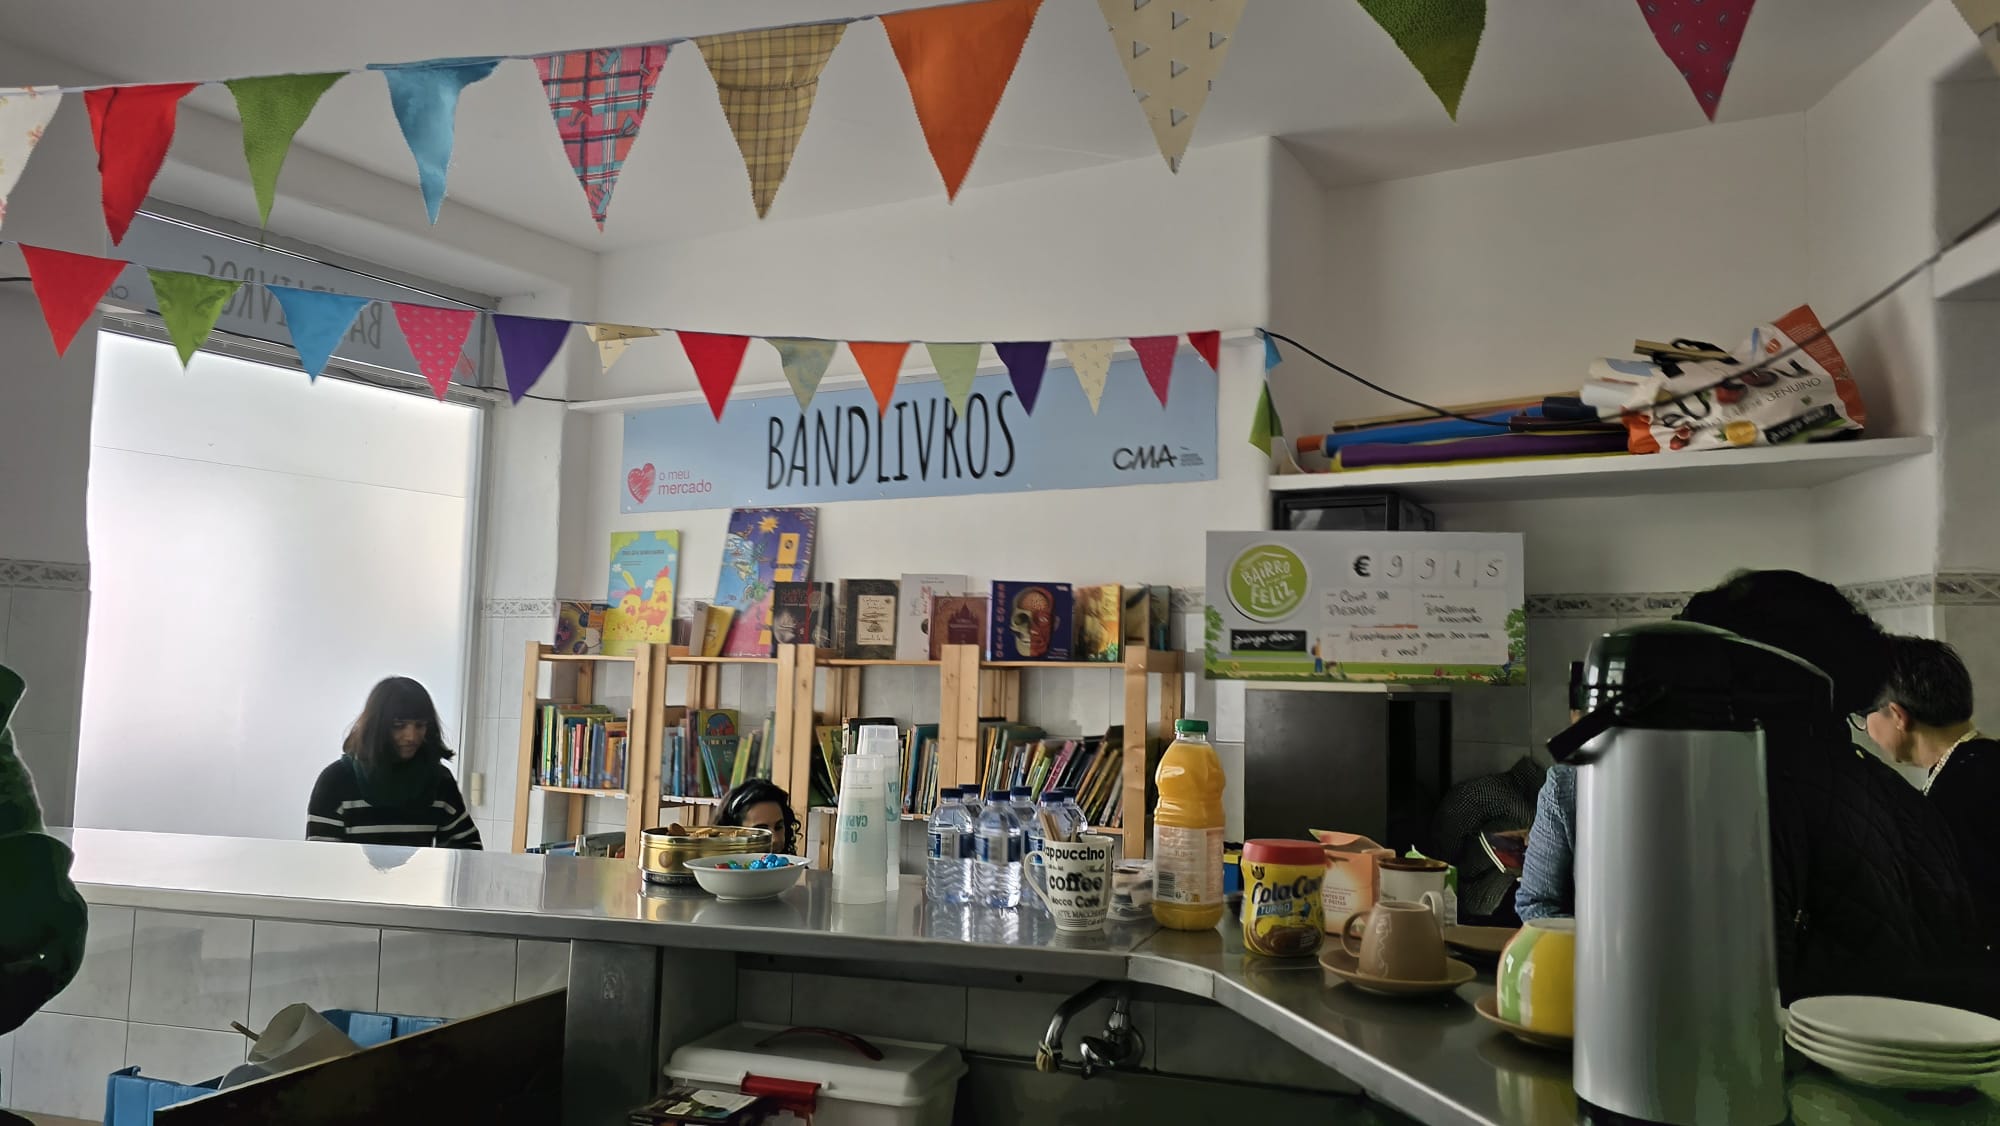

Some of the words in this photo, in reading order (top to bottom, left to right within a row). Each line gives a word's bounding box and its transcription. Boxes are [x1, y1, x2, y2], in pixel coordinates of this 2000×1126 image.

[767, 390, 1016, 490] BANDLIVROS
[1113, 443, 1178, 470] CMA
[658, 472, 666, 481] o
[668, 470, 690, 481] meu
[658, 479, 712, 495] mercado
[1240, 560, 1291, 586] BAIRRO
[1044, 846, 1105, 861] appuccino
[1049, 872, 1103, 892] coffee
